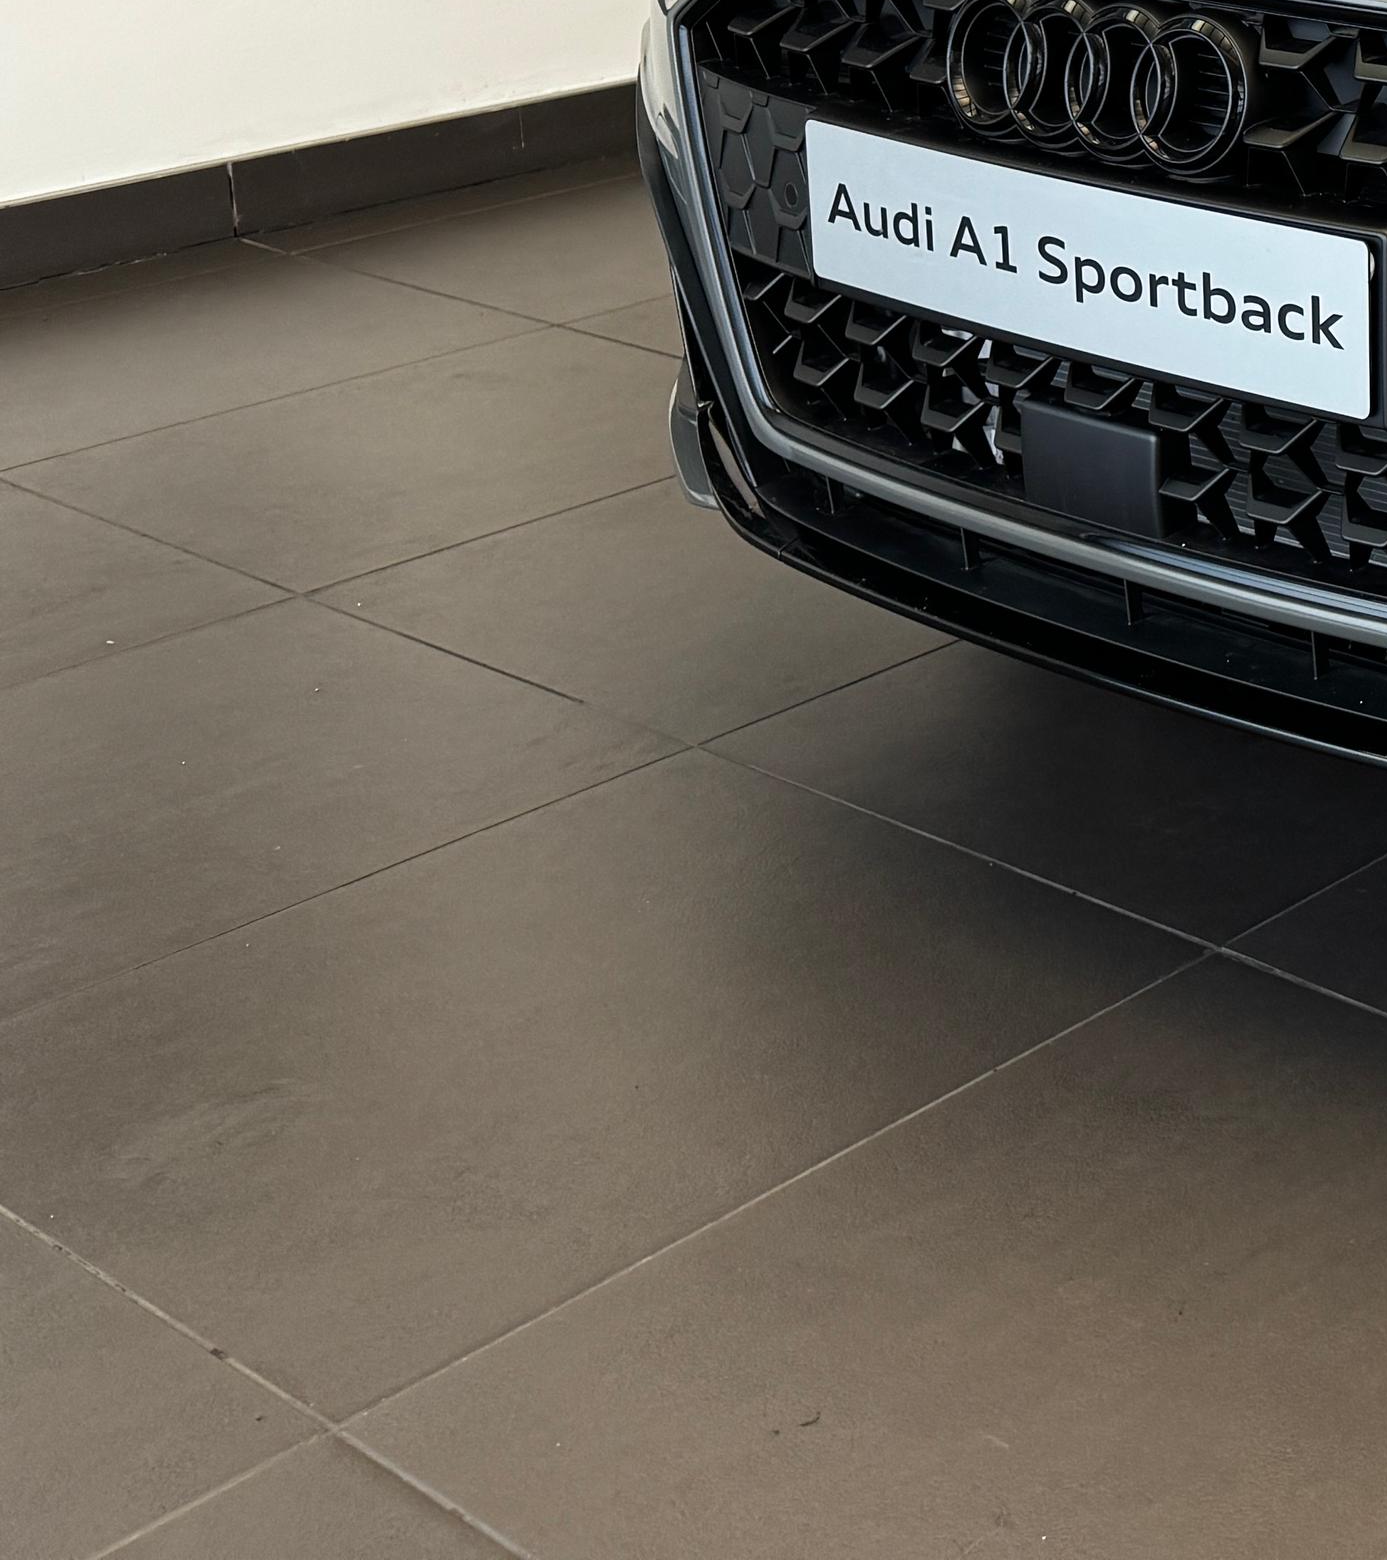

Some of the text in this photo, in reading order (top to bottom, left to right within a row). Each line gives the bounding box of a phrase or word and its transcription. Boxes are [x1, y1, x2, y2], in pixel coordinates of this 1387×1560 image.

[826, 182, 1346, 352] Audi A1 Sportback
